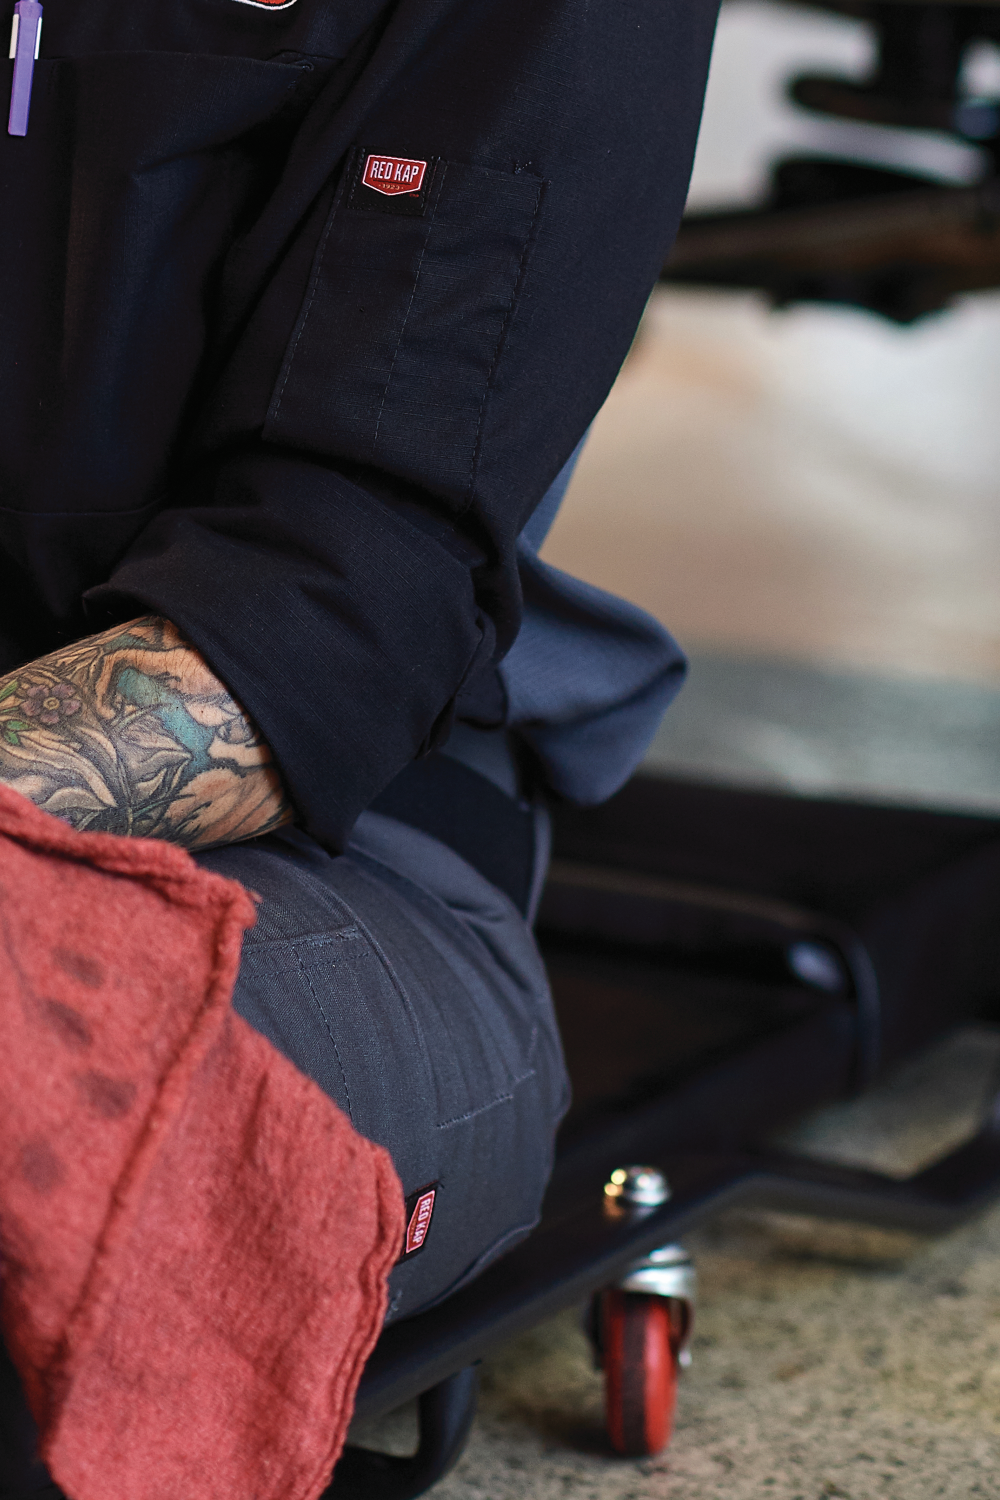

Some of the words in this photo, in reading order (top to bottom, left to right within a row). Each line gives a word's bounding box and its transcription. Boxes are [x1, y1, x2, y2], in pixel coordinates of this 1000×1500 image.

[370, 160, 393, 179] RED
[394, 163, 419, 183] KAP
[418, 1198, 431, 1221] RED
[412, 1221, 427, 1243] KAP
